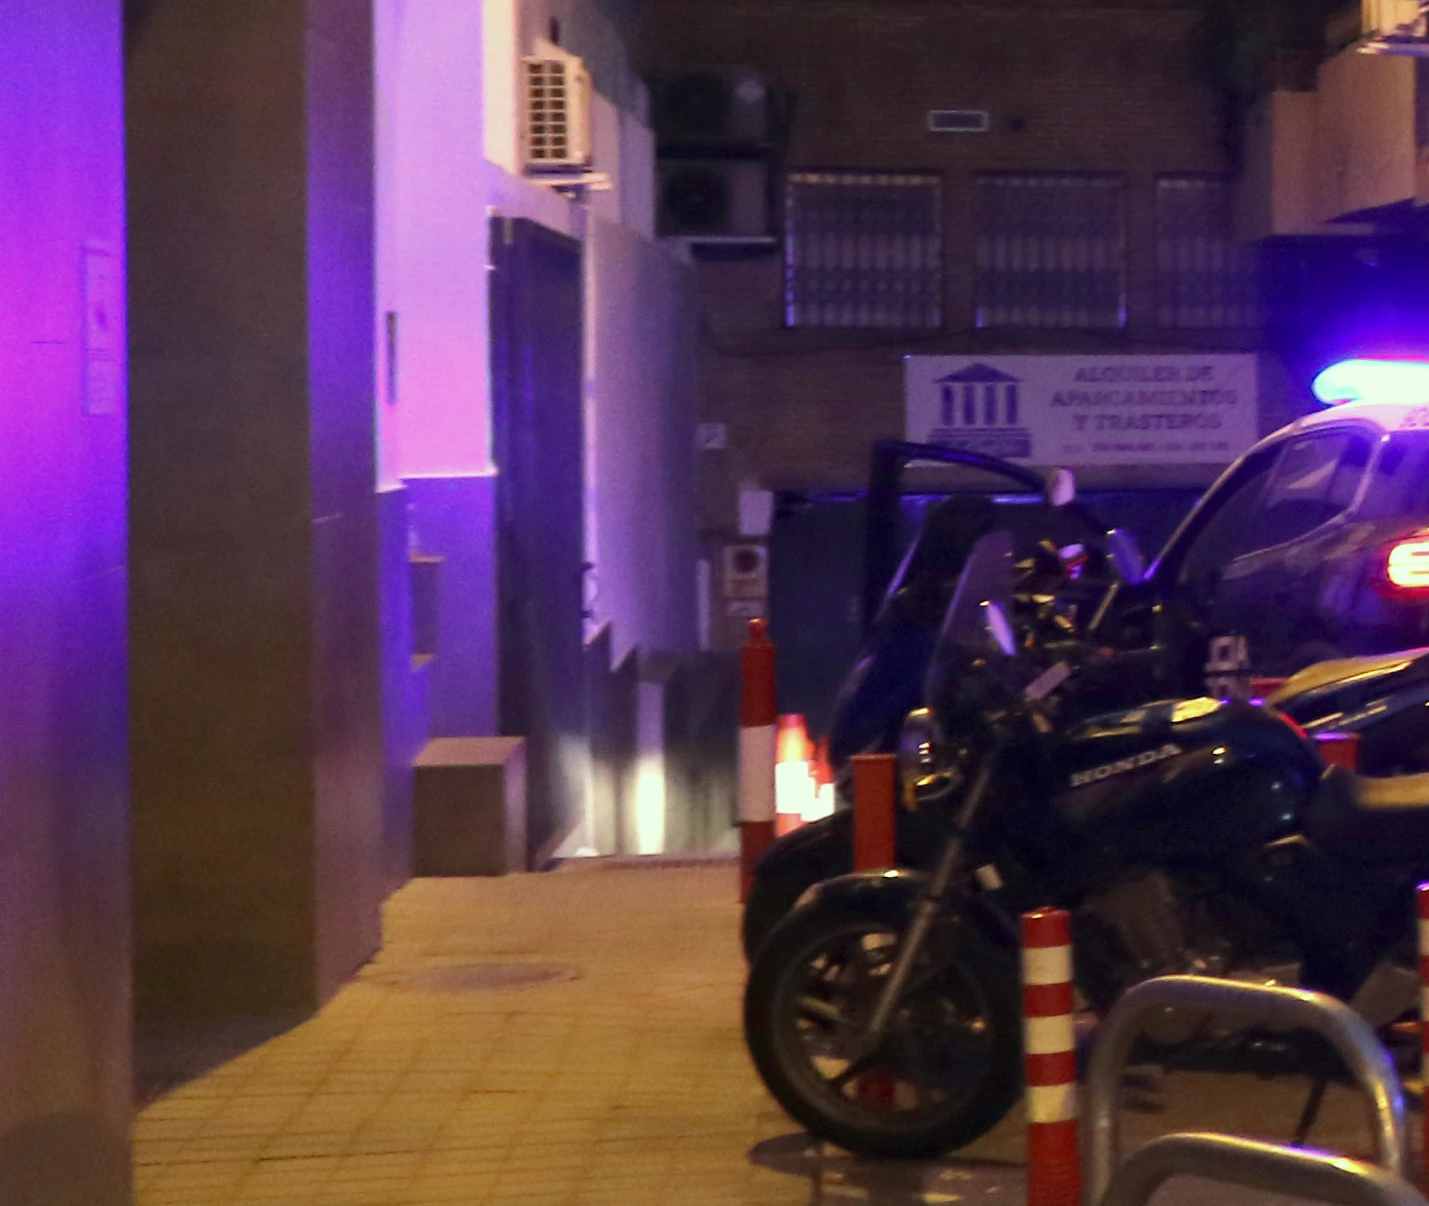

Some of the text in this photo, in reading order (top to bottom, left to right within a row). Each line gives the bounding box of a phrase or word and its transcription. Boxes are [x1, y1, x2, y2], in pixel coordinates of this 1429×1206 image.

[1074, 366, 1215, 382] ALQUILER DE
[1051, 389, 1238, 406] APARCAMIENTOS
[1072, 413, 1223, 430] Y TRASTEROS
[1070, 743, 1183, 787] HONDA
